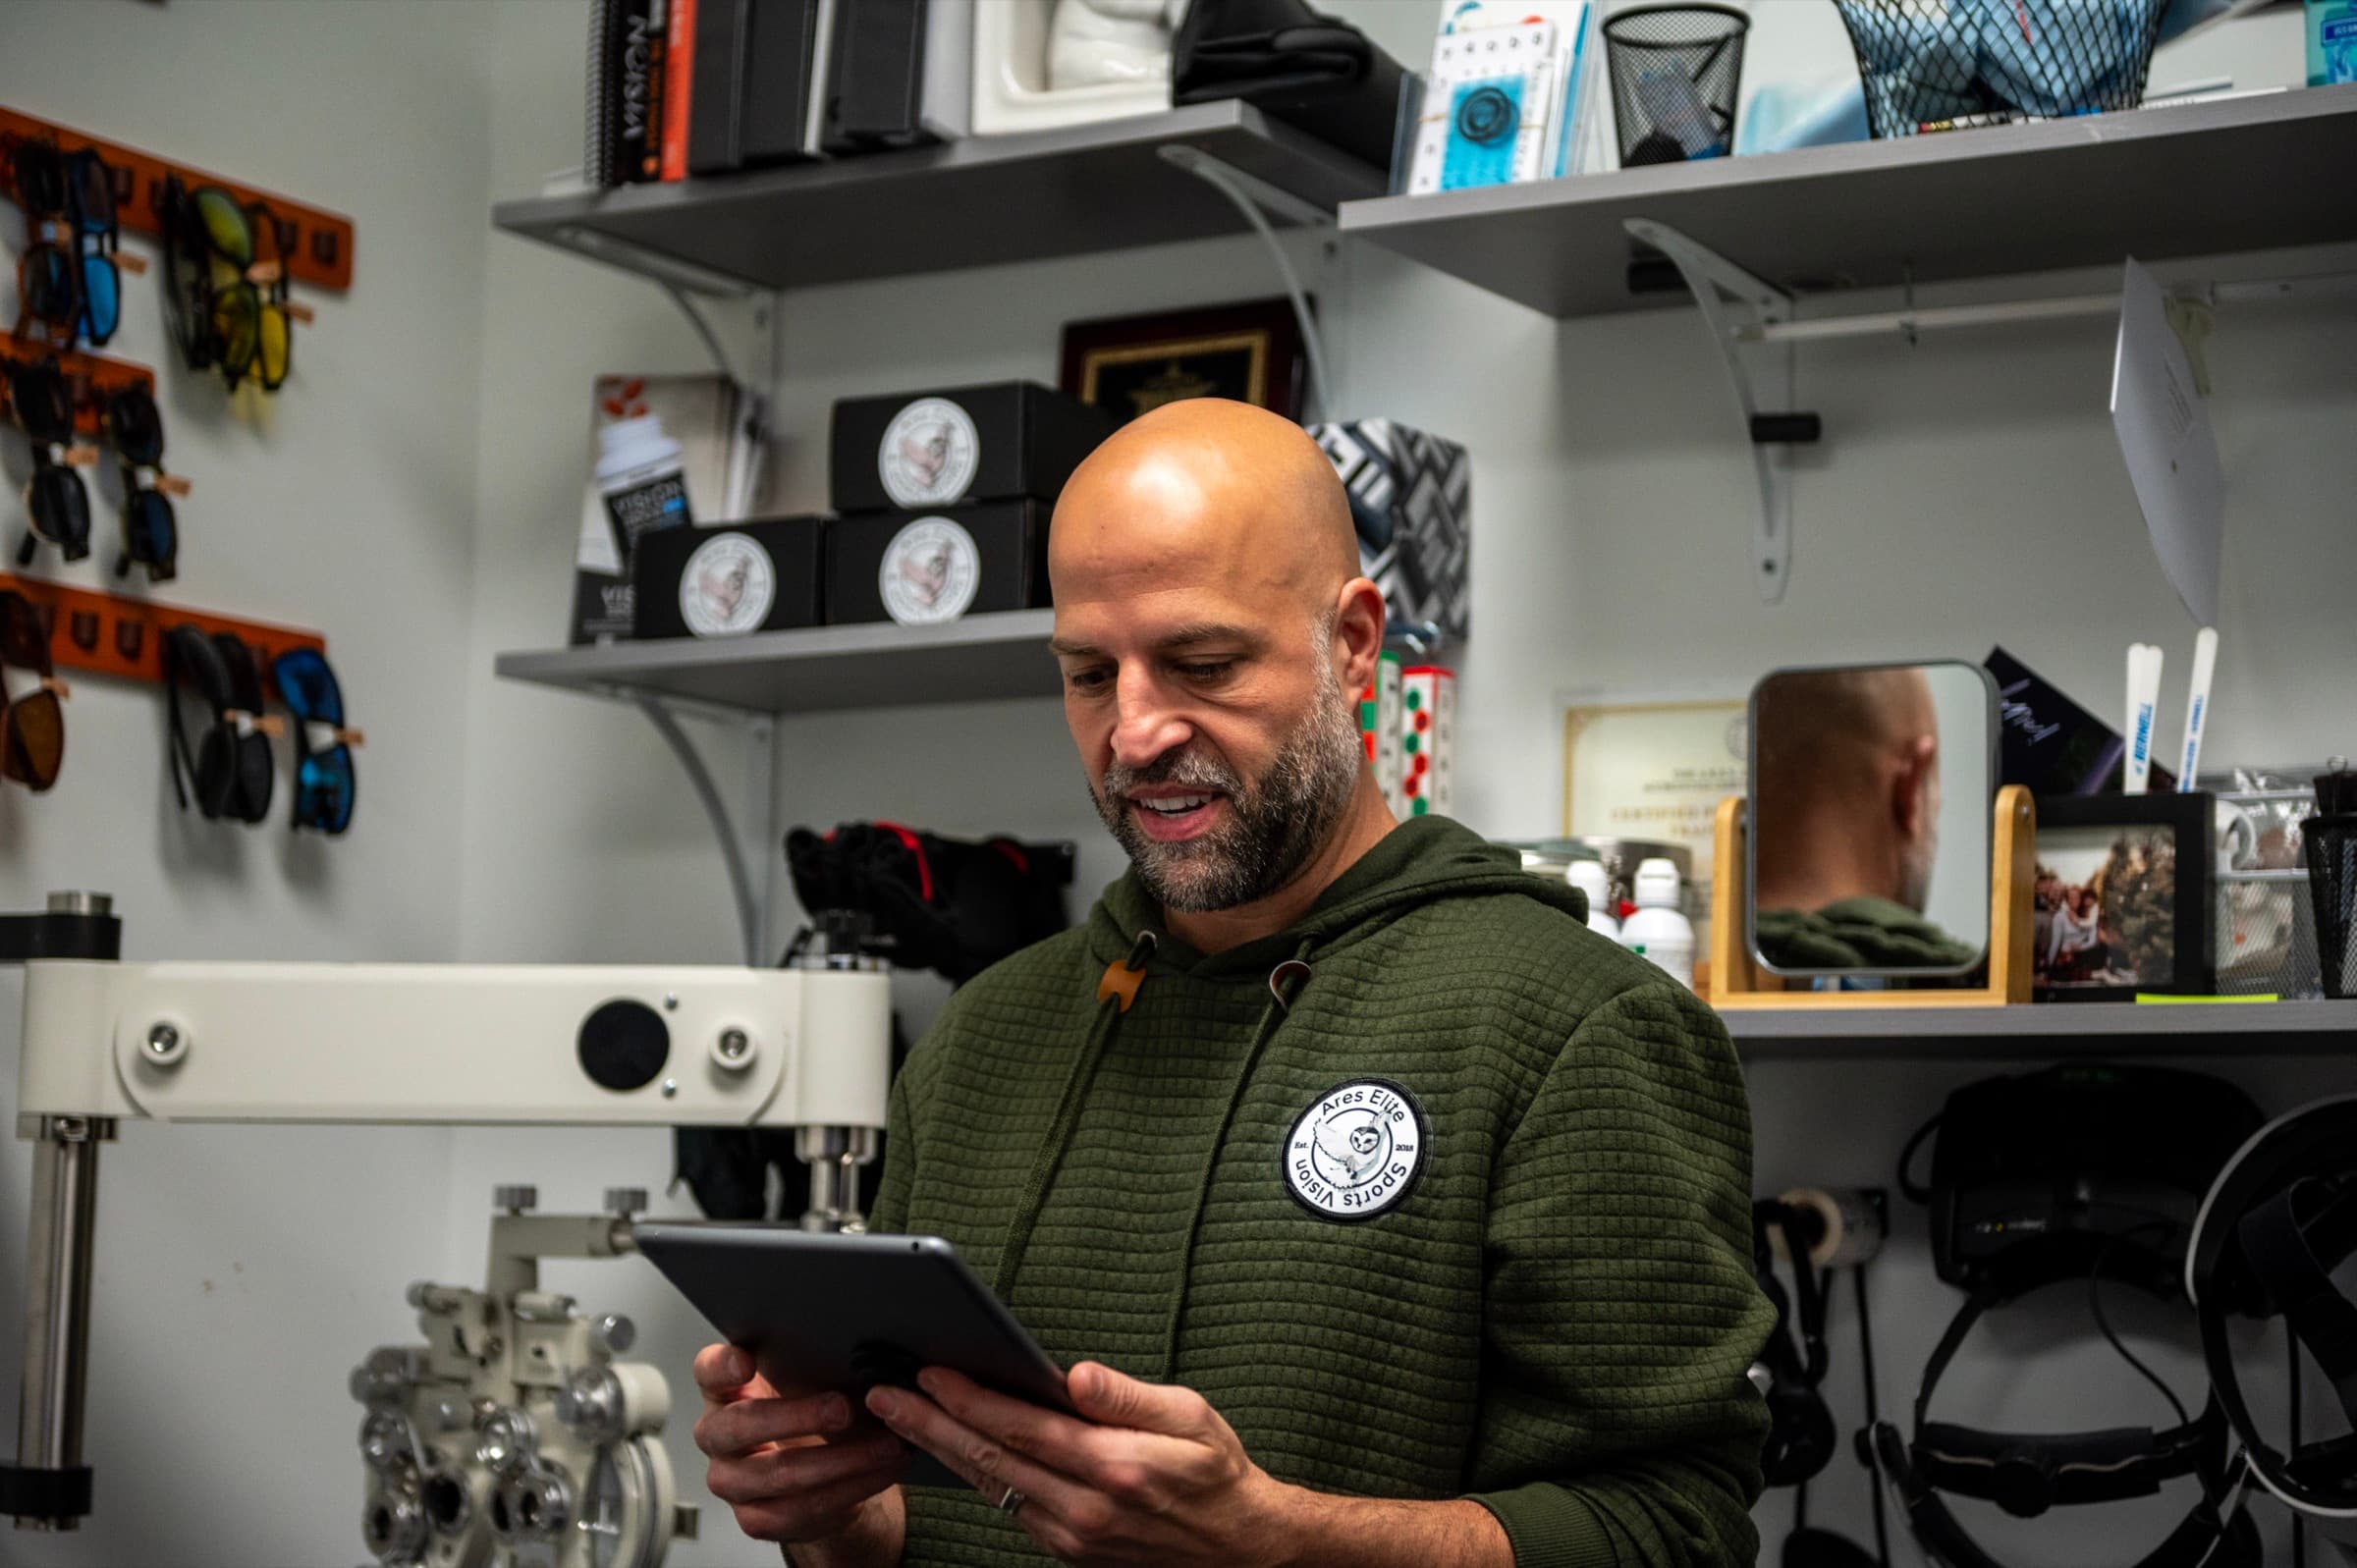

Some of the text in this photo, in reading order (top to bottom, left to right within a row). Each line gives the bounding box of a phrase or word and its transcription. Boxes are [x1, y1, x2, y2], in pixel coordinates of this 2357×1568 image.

[1322, 1089, 1405, 1123] Ares Elite
[1294, 1141, 1308, 1150] Est.
[1295, 1159, 1407, 1208] Sports Vision
